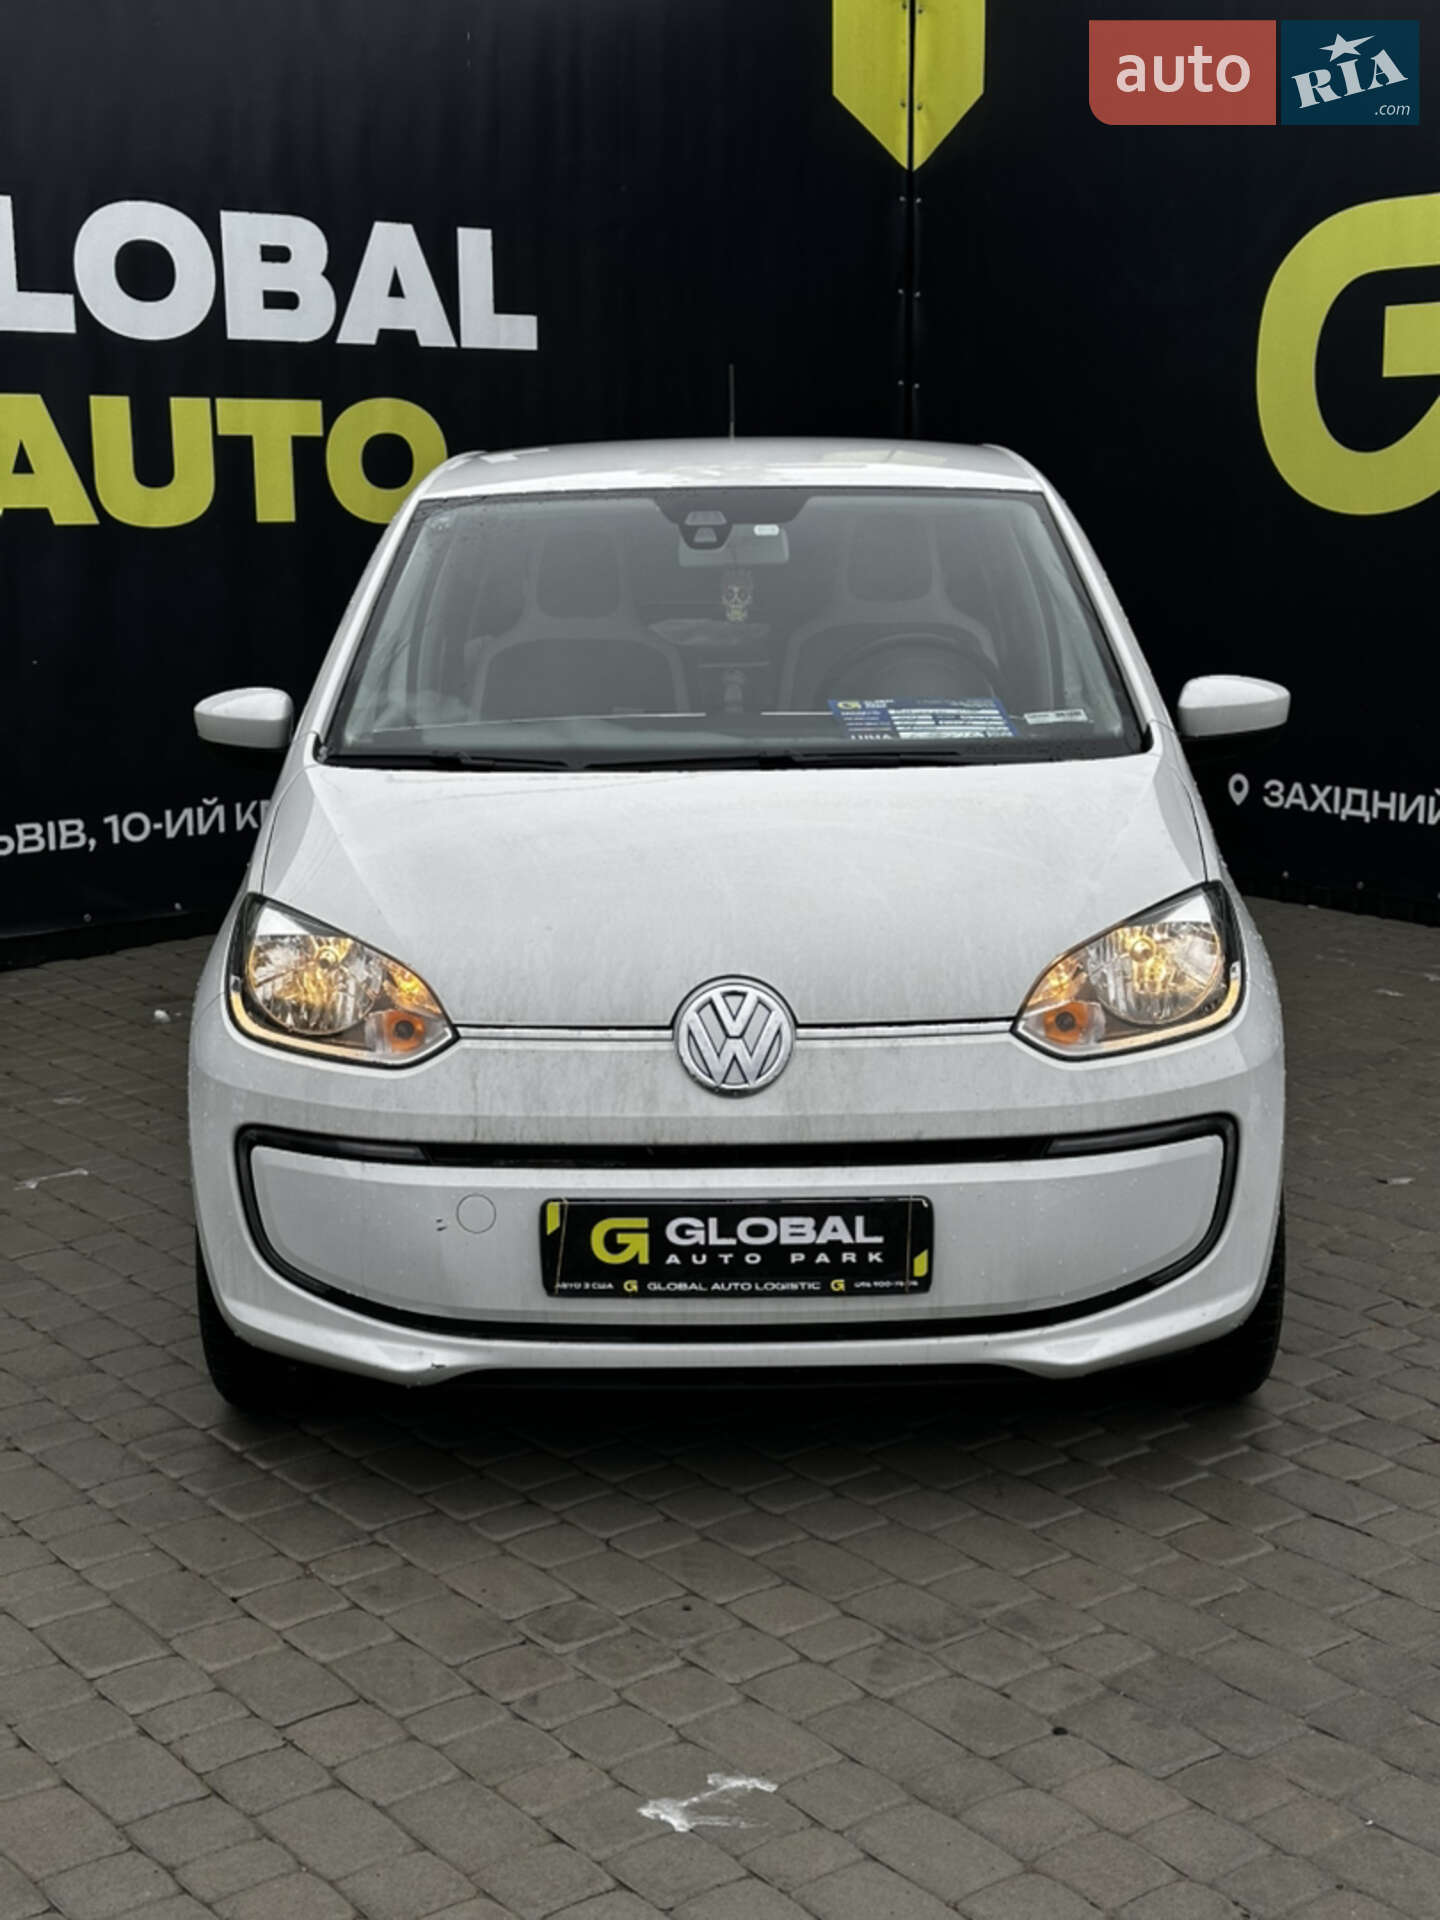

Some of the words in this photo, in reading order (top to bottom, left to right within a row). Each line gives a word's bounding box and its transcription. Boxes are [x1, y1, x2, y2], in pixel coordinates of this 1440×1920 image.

[103, 797, 226, 844] 10-ИЙ
[665, 1215, 885, 1246] GLOBAL
[665, 1252, 762, 1266] AUTO
[790, 1251, 884, 1265] PARK
[646, 1281, 708, 1292] GLOBAL
[710, 1281, 753, 1292] AUTO
[754, 1281, 822, 1292] LOGISTIC
